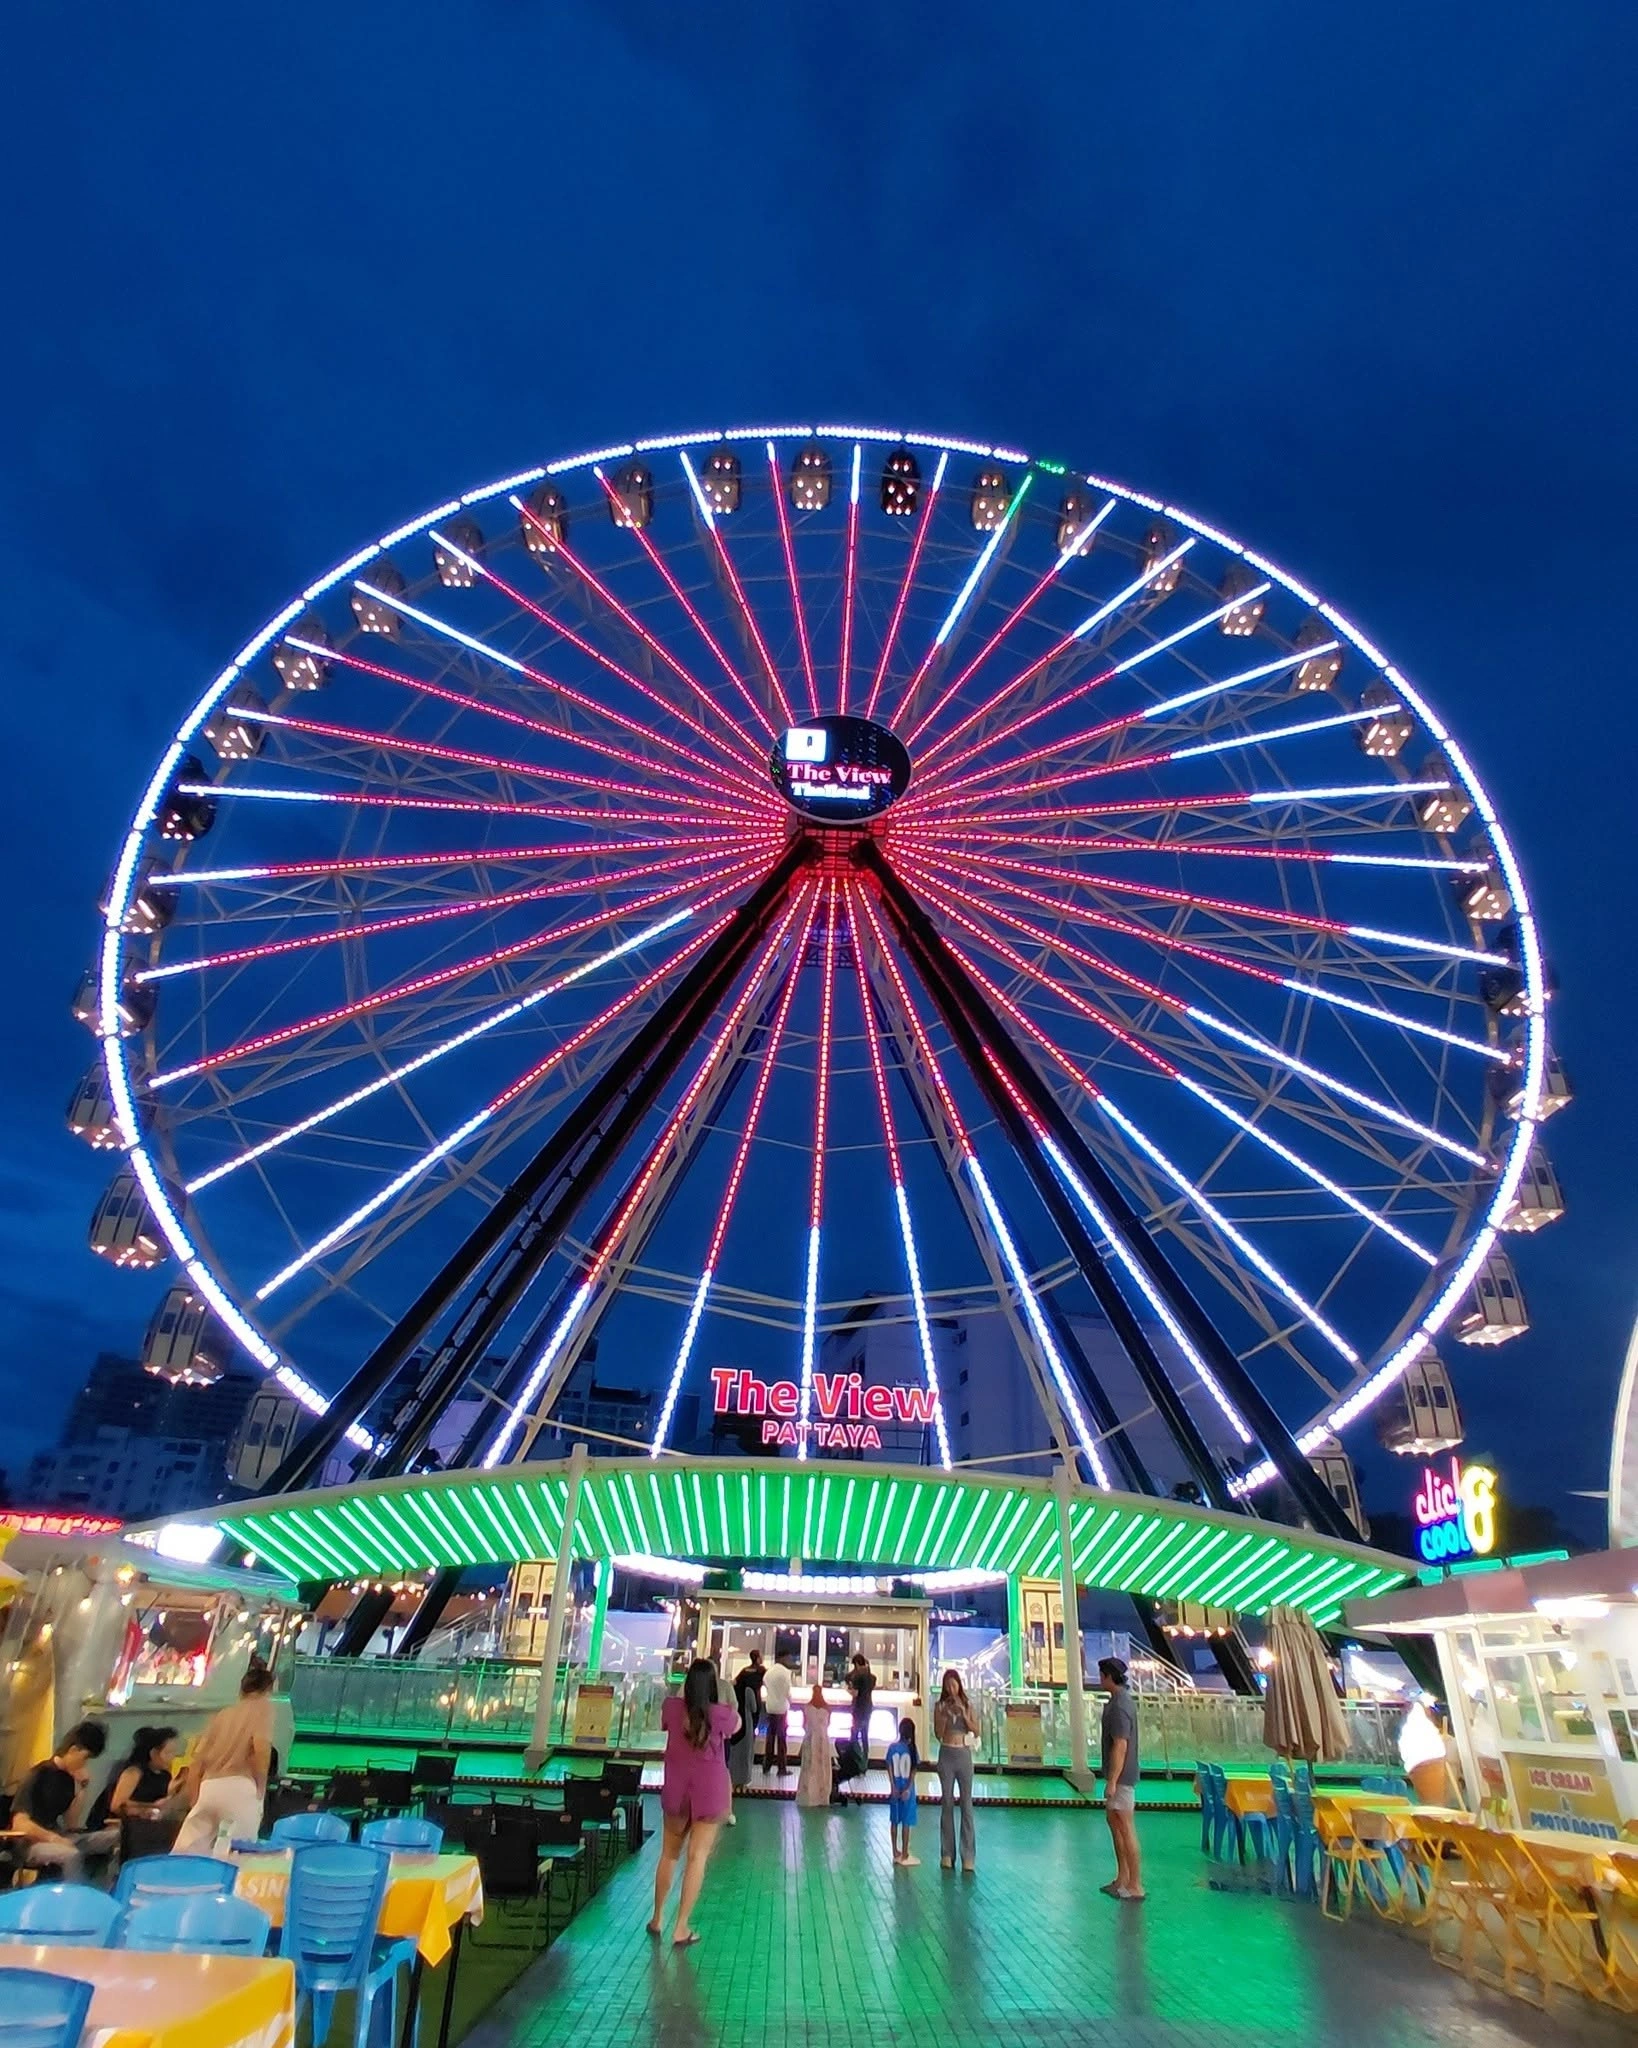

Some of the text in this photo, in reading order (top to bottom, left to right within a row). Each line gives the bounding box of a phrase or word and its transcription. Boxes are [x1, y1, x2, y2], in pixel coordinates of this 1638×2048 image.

[787, 763, 892, 784] The View
[711, 1367, 938, 1423] The View
[762, 1420, 882, 1449] PATTAYA
[892, 1752, 911, 1779] 10
[1550, 1769, 1594, 1795] CREAM
[1530, 1810, 1570, 1832] PHOTO
